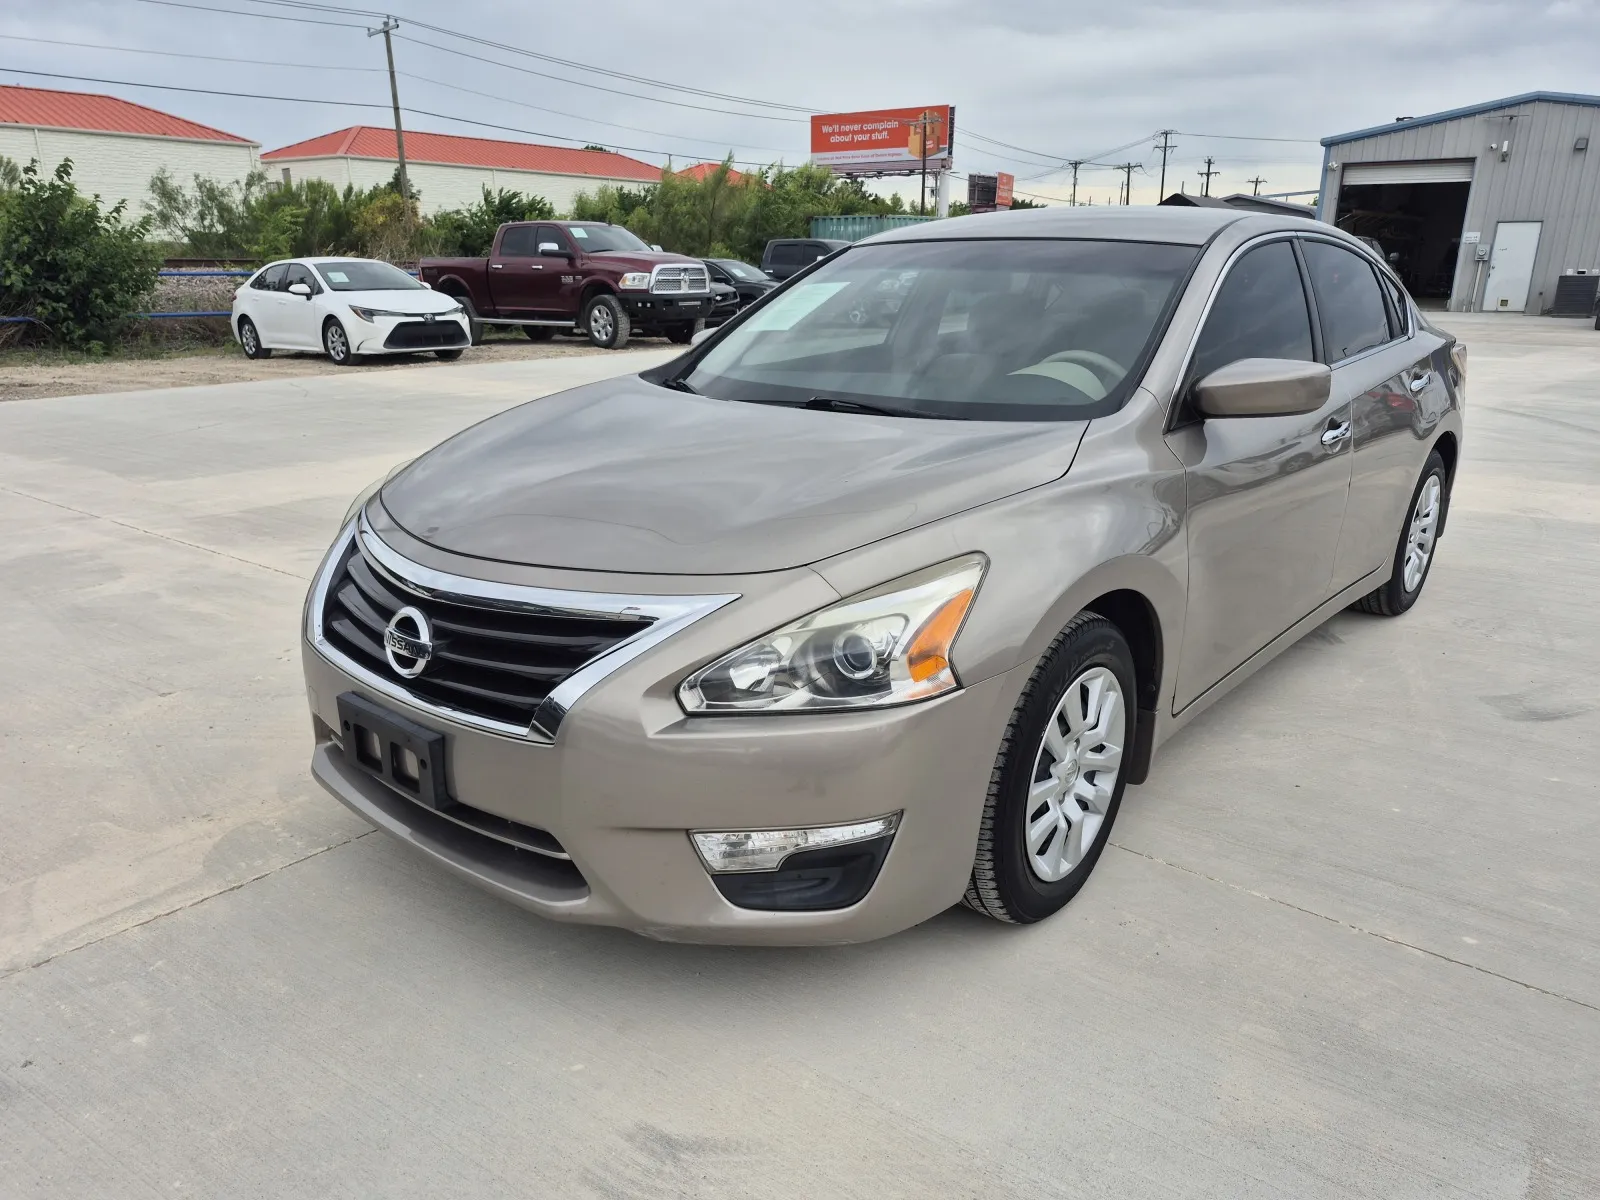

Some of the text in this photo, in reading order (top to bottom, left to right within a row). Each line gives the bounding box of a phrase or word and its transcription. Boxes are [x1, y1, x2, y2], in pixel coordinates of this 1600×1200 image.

[821, 119, 899, 134] We'll never complain
[830, 130, 890, 143] about your stuff.
[386, 630, 419, 657] NISSAN
